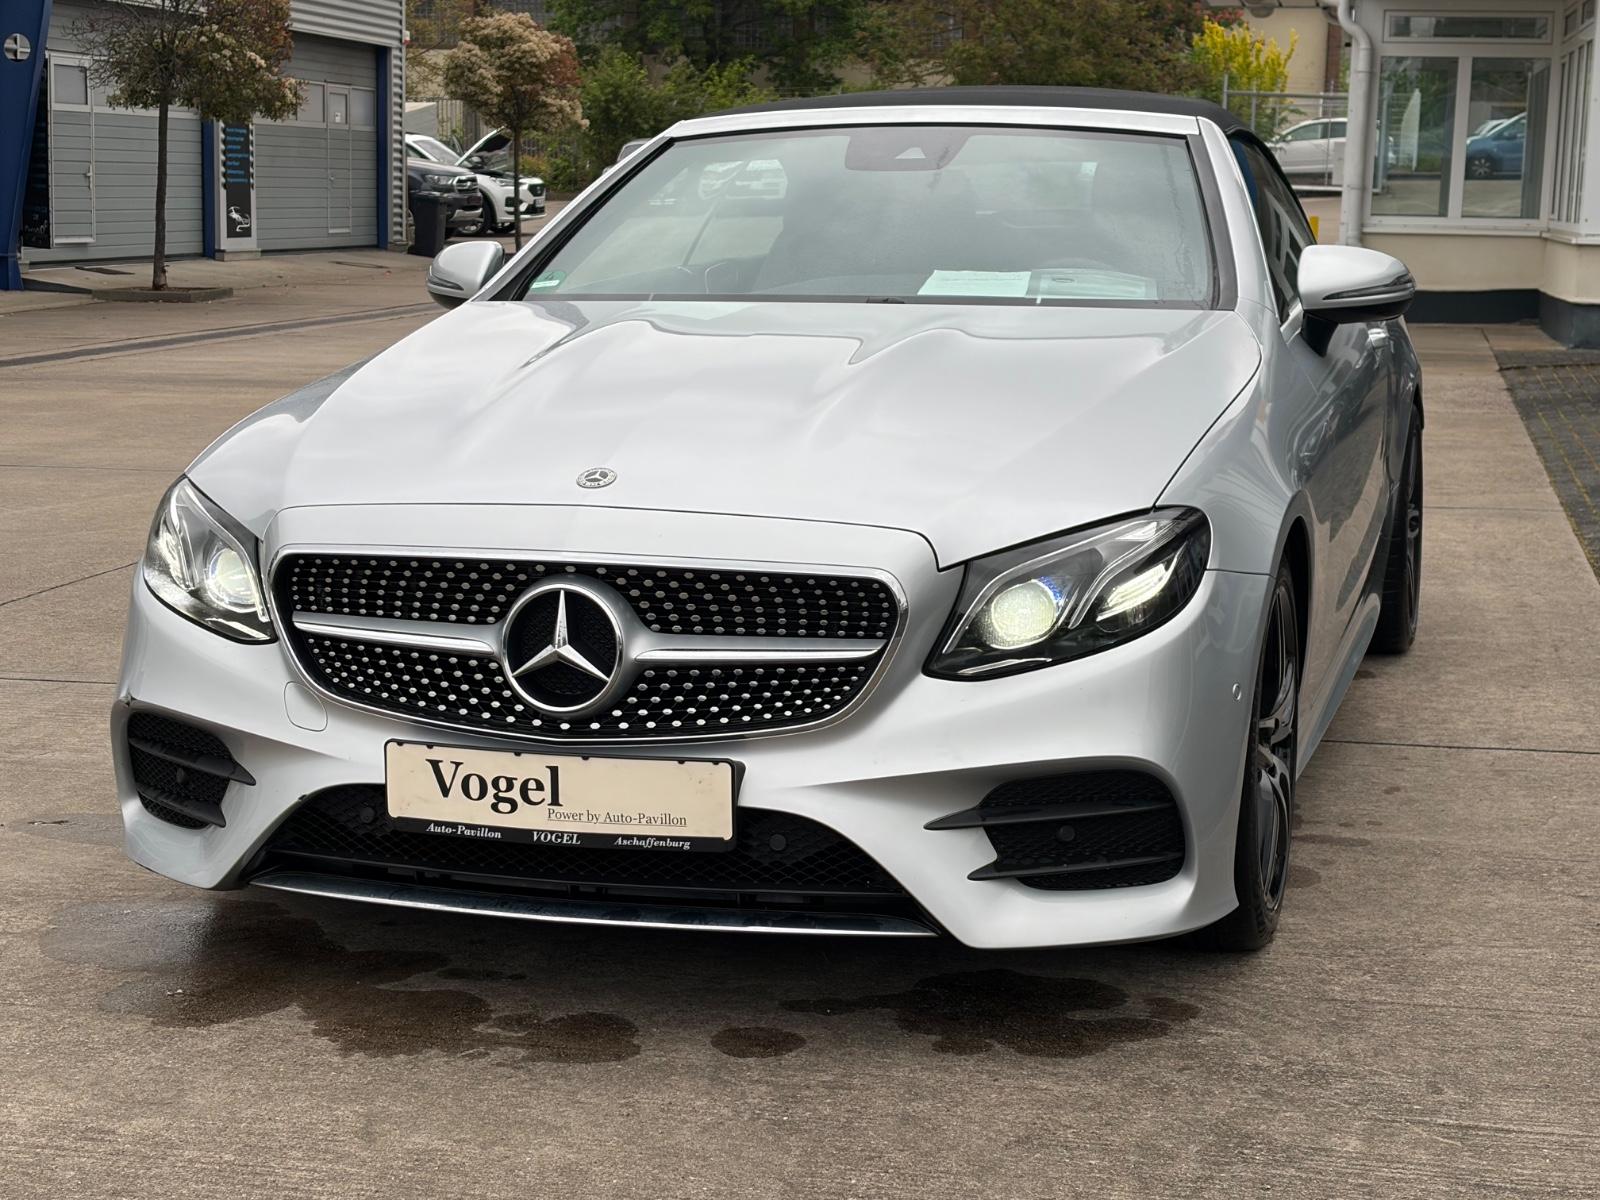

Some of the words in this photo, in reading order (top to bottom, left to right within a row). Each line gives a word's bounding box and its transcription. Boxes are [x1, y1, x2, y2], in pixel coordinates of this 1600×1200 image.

[424, 758, 563, 815] Vogel
[547, 807, 584, 821] Power
[586, 809, 600, 824] by
[603, 811, 687, 826] Auto-Pavillon
[426, 822, 502, 839] Auto-Pavillon
[531, 831, 581, 845] VOGEL
[614, 836, 691, 850] Aschaffenburg
